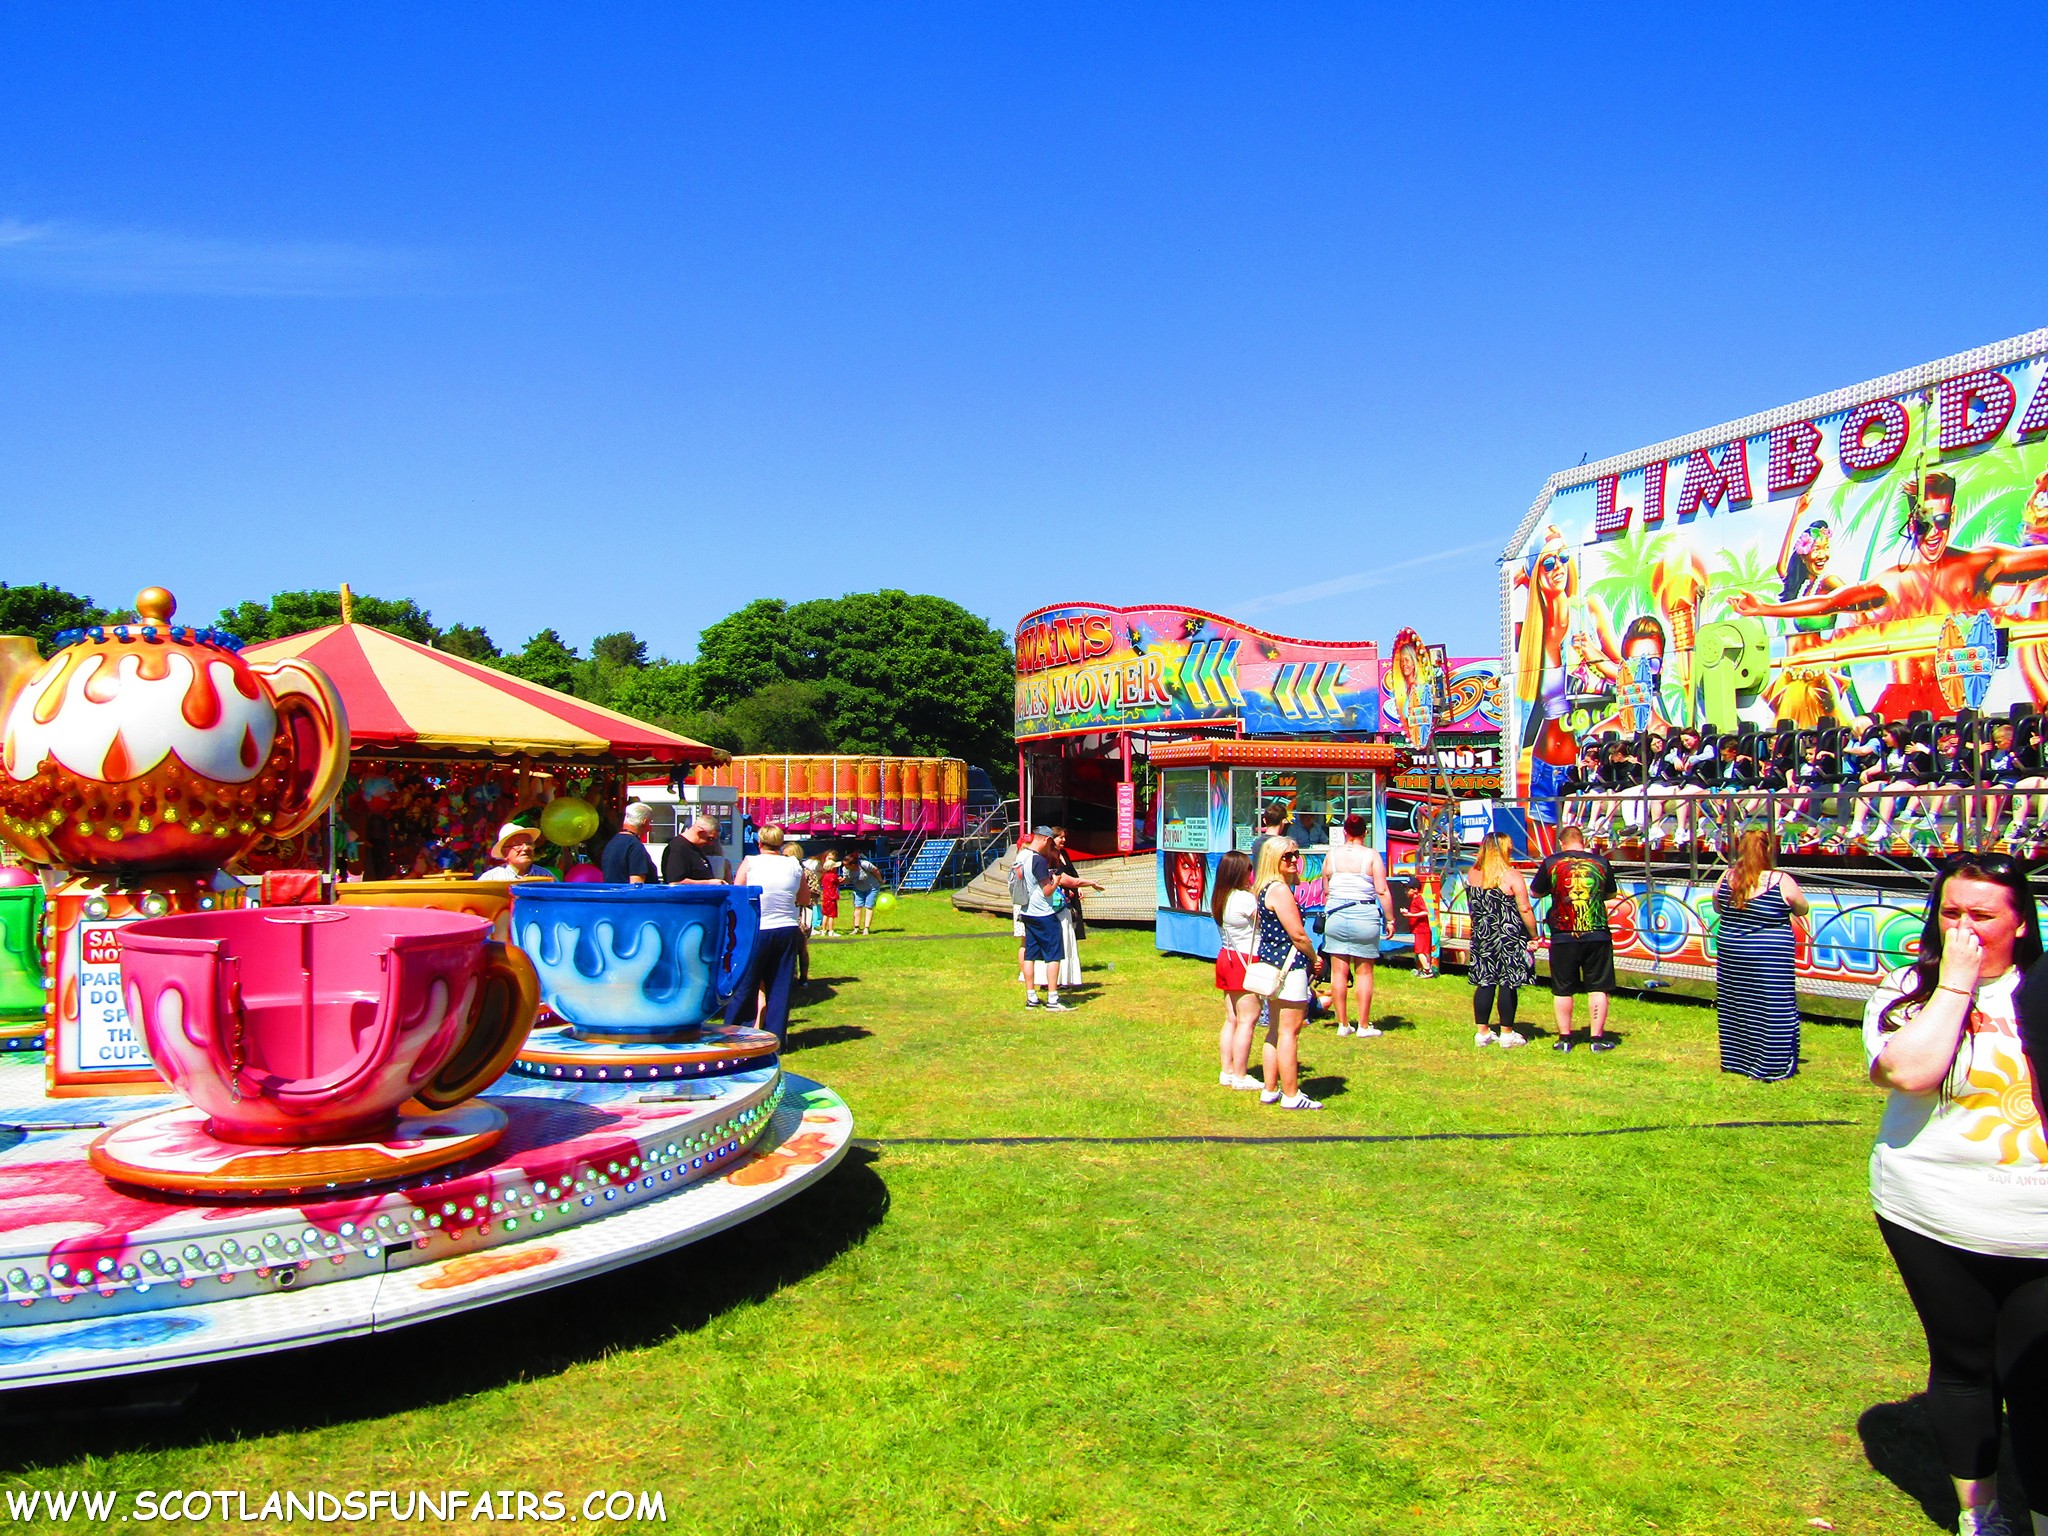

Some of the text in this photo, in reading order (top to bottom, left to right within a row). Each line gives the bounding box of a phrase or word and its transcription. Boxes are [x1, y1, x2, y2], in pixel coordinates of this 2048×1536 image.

[1595, 399, 1911, 534] LIMBO
[1946, 647, 1988, 662] LIMBO
[1940, 660, 1991, 675] DANCER
[1053, 652, 1173, 716] MOVER
[1411, 749, 1493, 768] THE NO.1
[1404, 767, 1501, 776] ACROSS
[1393, 775, 1431, 789] THE
[1462, 816, 1489, 826] ENTRANCE
[89, 930, 122, 947] SA
[82, 972, 121, 986] PAR
[90, 990, 118, 1005] DO
[102, 1009, 127, 1023] SP
[107, 1028, 138, 1042] TH
[1987, 1173, 2048, 1187] SAN ANTO
